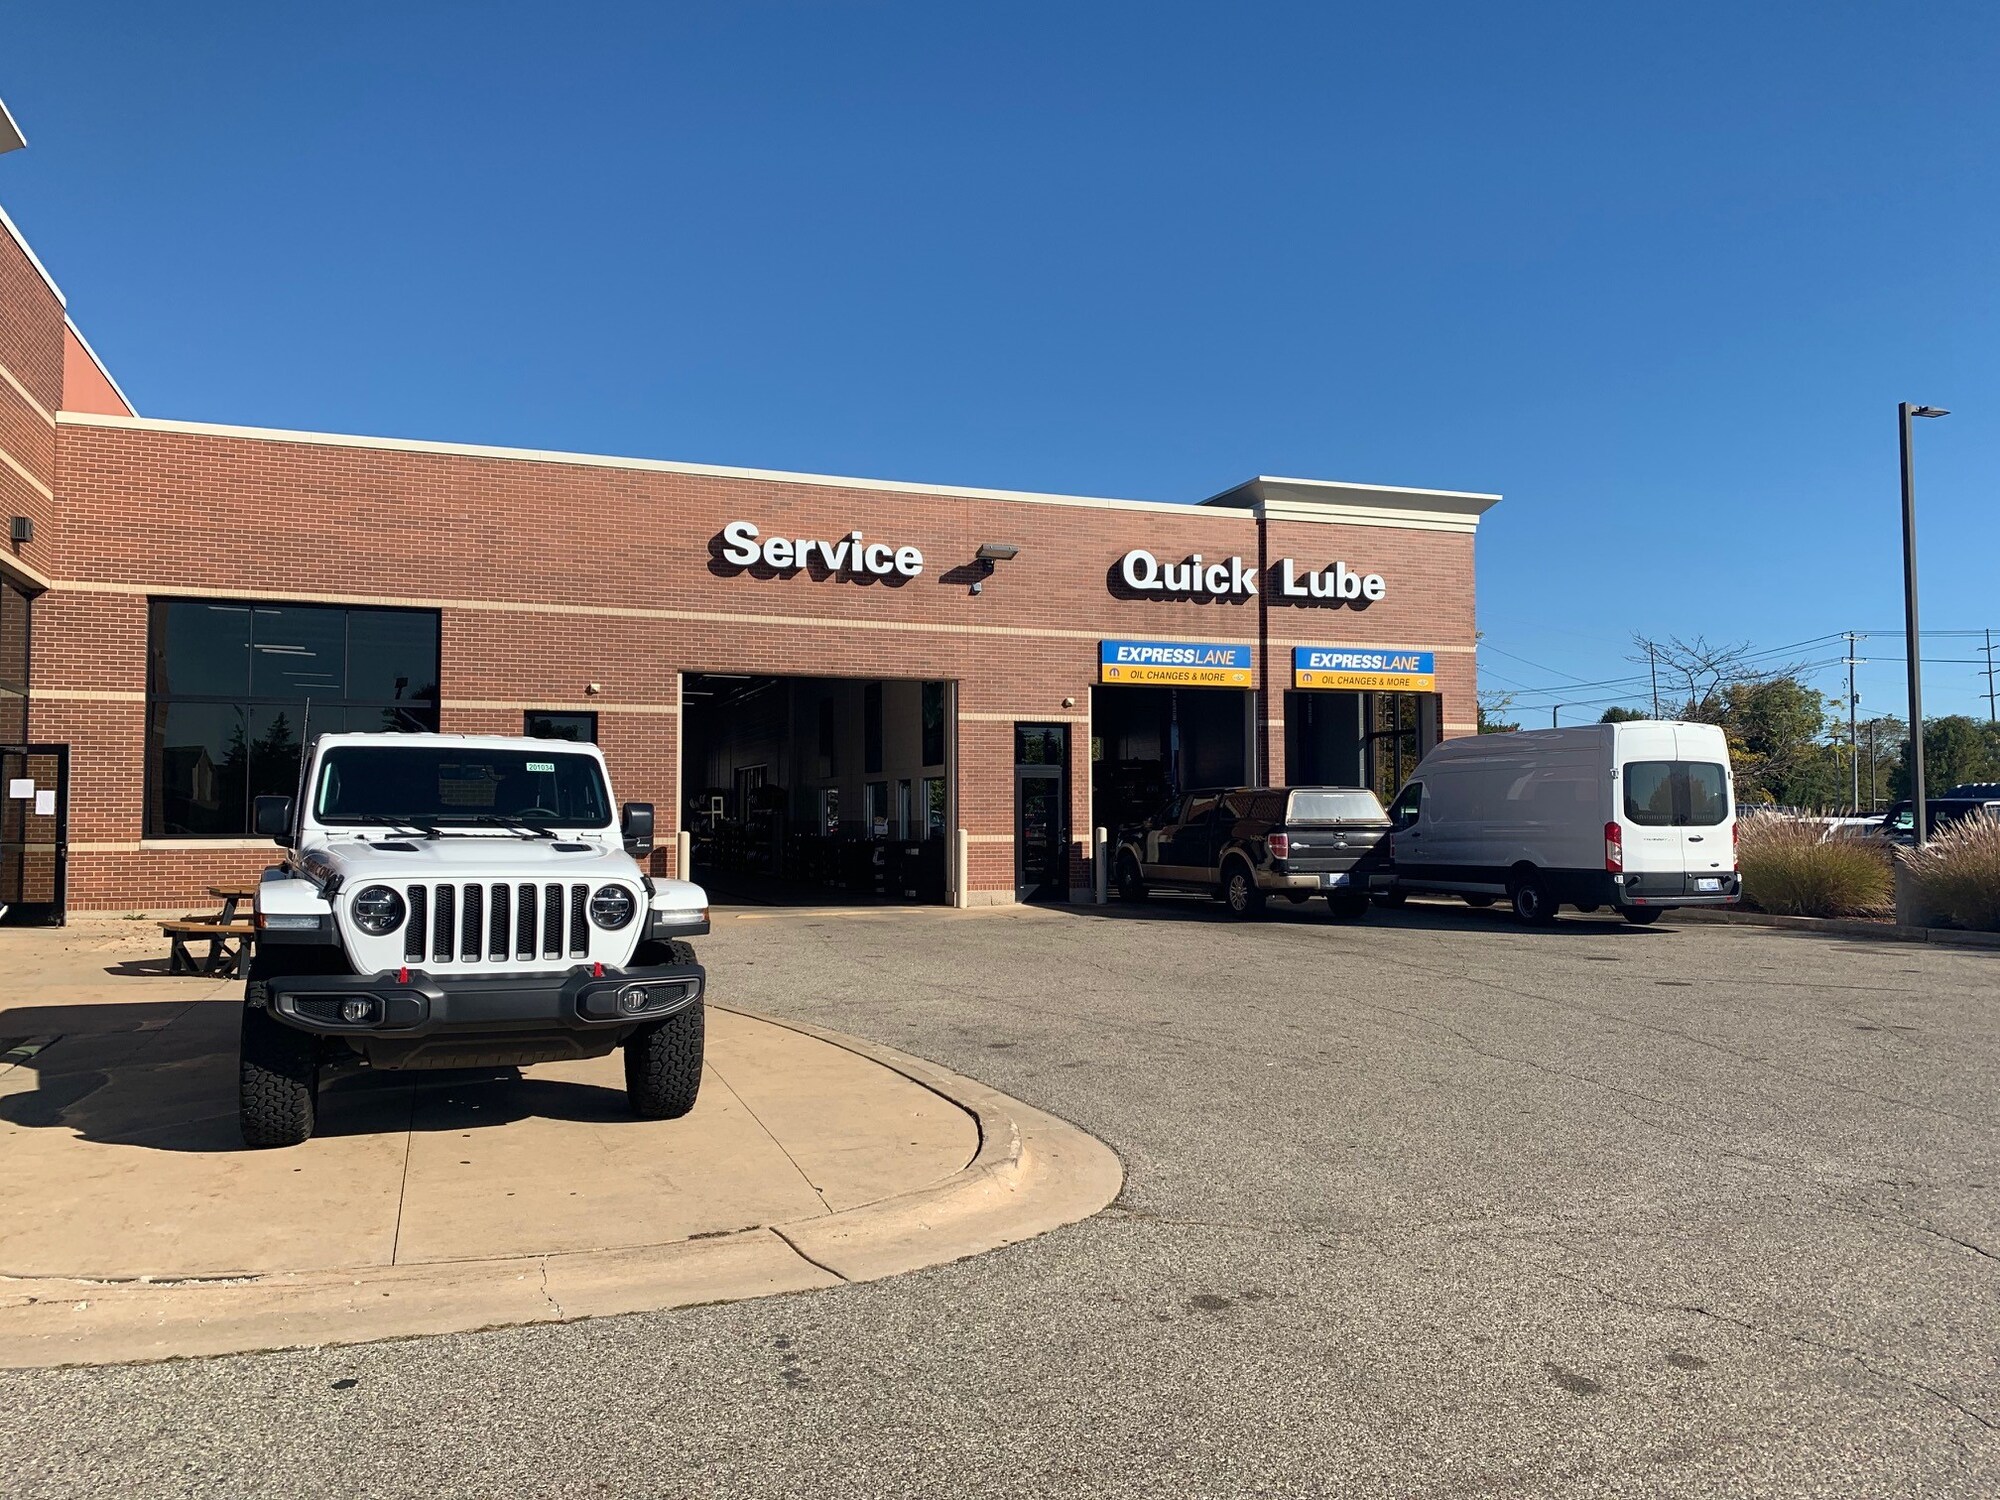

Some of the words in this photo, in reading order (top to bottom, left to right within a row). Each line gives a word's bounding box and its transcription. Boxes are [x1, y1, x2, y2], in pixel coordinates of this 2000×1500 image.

[723, 520, 924, 576] Service
[1122, 549, 1259, 595] Quick
[1283, 558, 1386, 601] Lube
[1130, 670, 1145, 679] OIL
[1146, 671, 1190, 681] CHANGES
[1191, 673, 1198, 681] &
[1199, 672, 1226, 682] MORE
[1321, 675, 1335, 684] OIL
[1337, 676, 1377, 686] CHANGES
[1378, 678, 1385, 686] &
[1386, 677, 1411, 687] MORE
